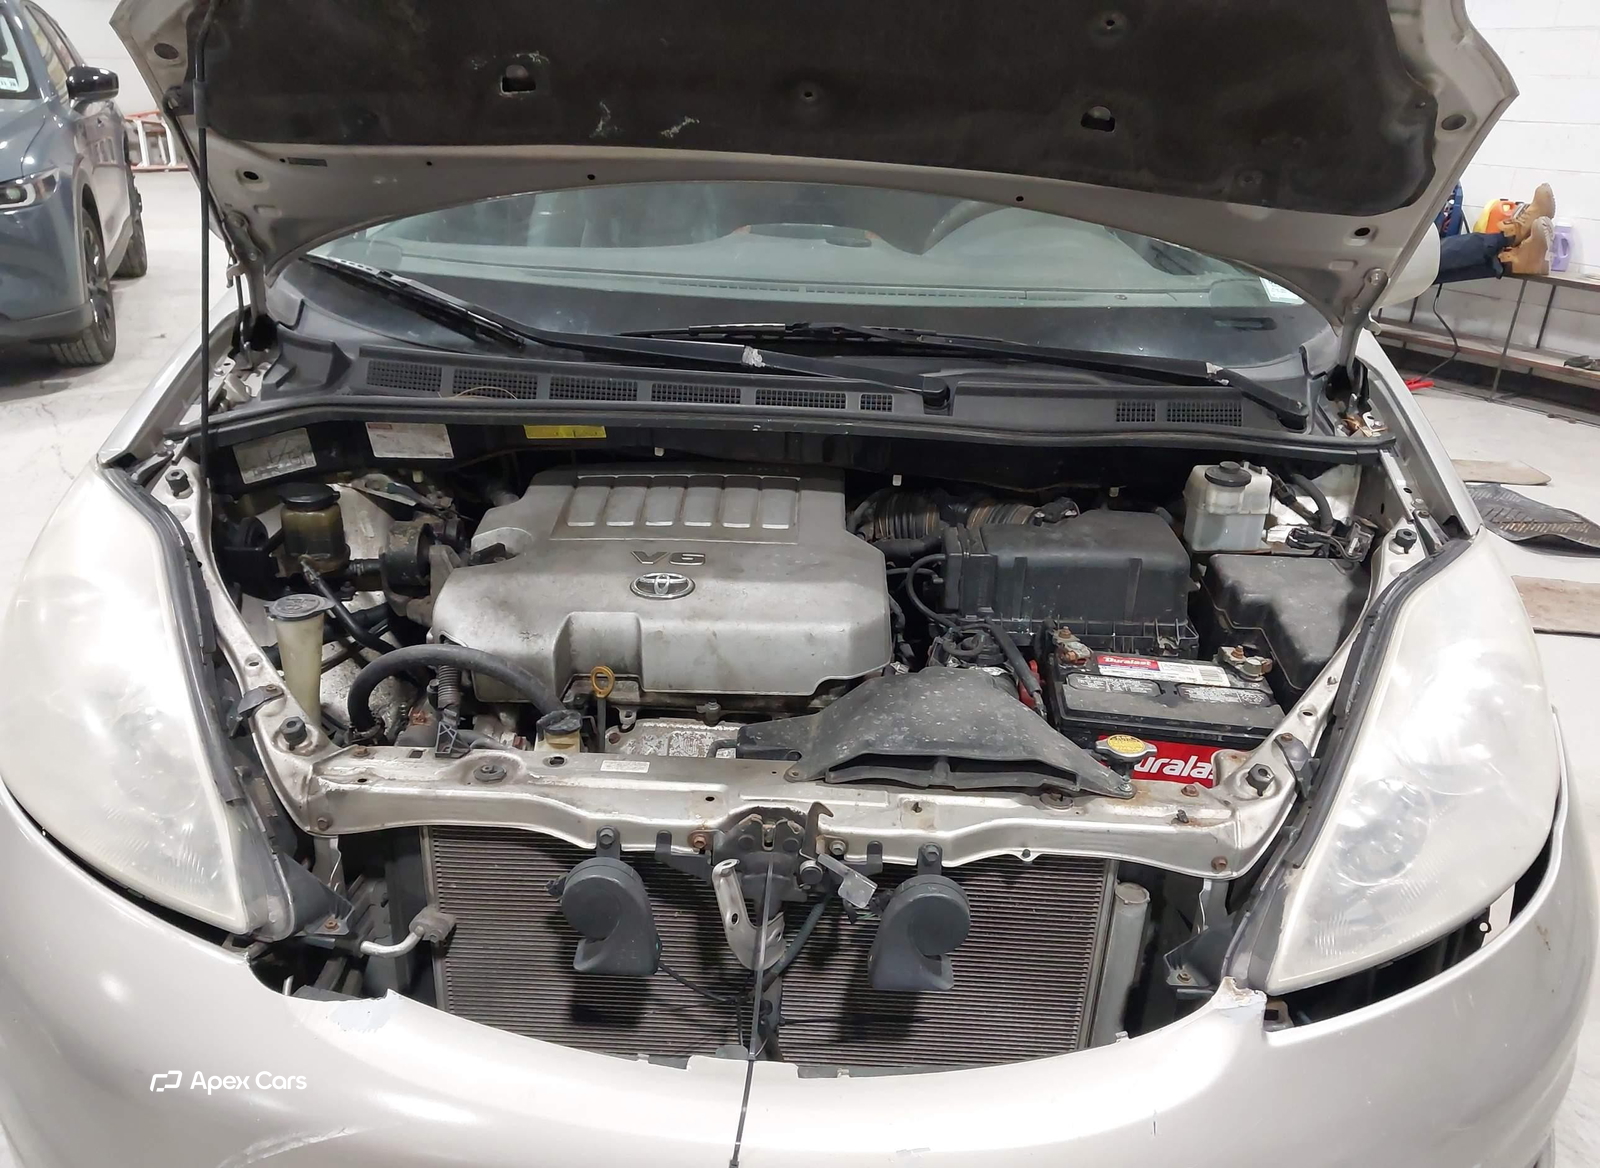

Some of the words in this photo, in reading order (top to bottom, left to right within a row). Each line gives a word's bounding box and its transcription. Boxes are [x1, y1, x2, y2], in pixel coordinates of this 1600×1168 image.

[631, 551, 706, 566] V6
[1104, 656, 1152, 666] Duralast
[1134, 755, 1213, 780] urala
